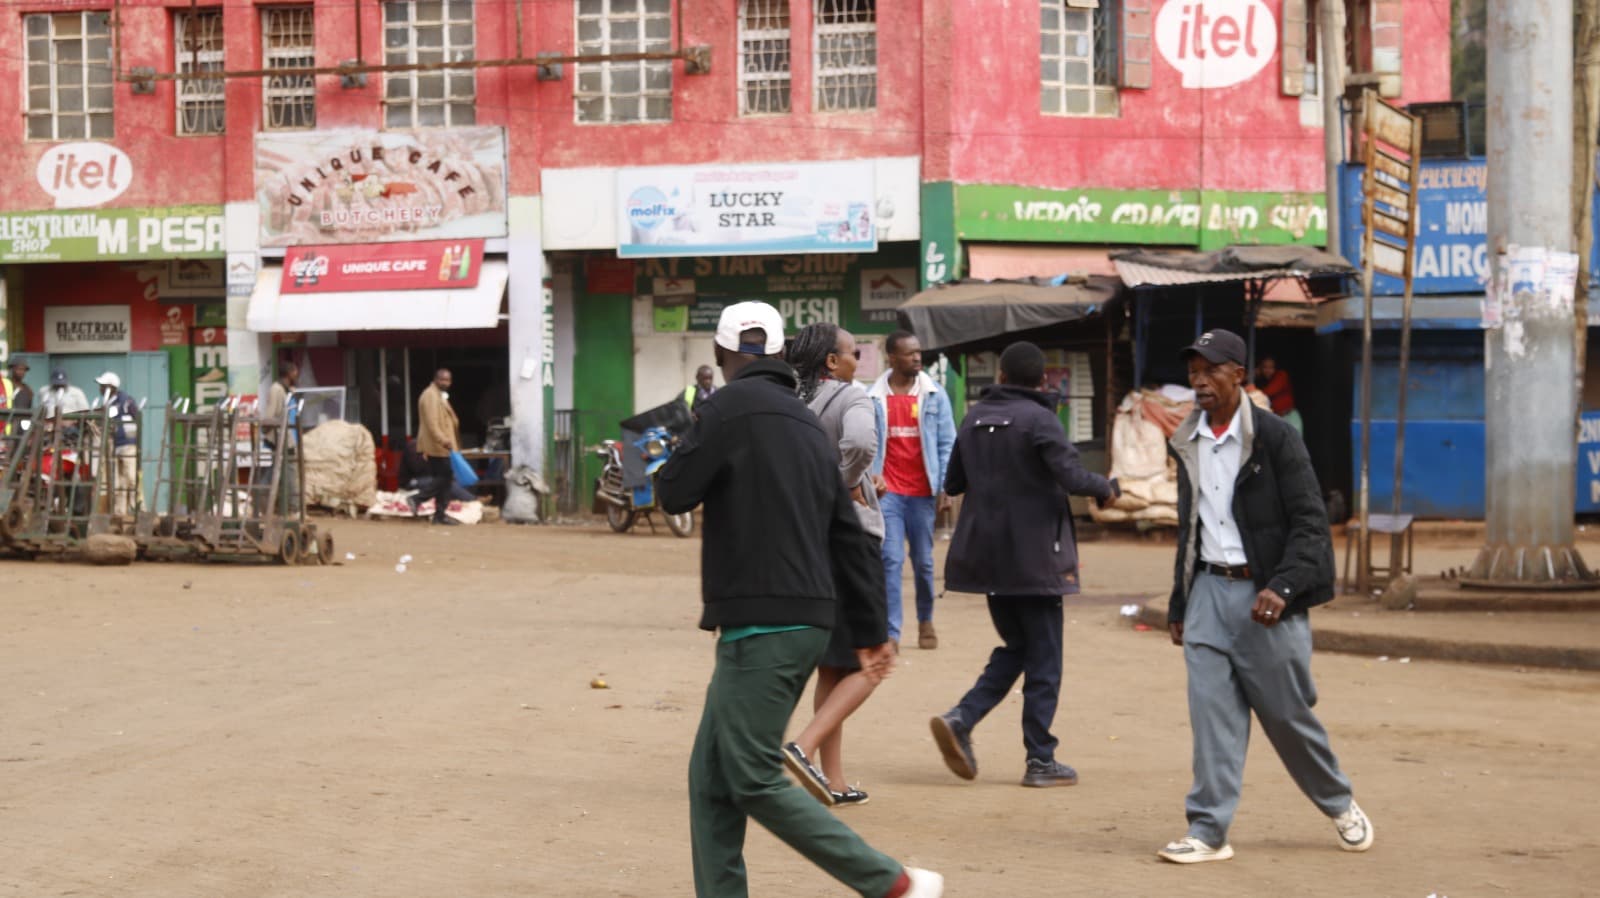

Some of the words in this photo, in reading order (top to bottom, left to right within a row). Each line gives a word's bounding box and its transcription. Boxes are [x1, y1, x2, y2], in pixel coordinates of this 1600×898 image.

[1177, 3, 1258, 59] itel
[53, 153, 118, 190] itel
[288, 146, 384, 207] UNIQUE
[408, 150, 475, 199] CAFE
[709, 191, 784, 207] LUCKY
[320, 206, 442, 225] BUTCHERY
[630, 204, 675, 217] molfix
[0, 214, 98, 239] LECTRICAL
[718, 212, 776, 228] STAR
[12, 239, 51, 253] SHOP
[342, 262, 390, 275] UNIQUE
[392, 259, 426, 272] CAFE
[780, 297, 840, 330] PESA
[56, 321, 127, 334] ELECTRICAL
